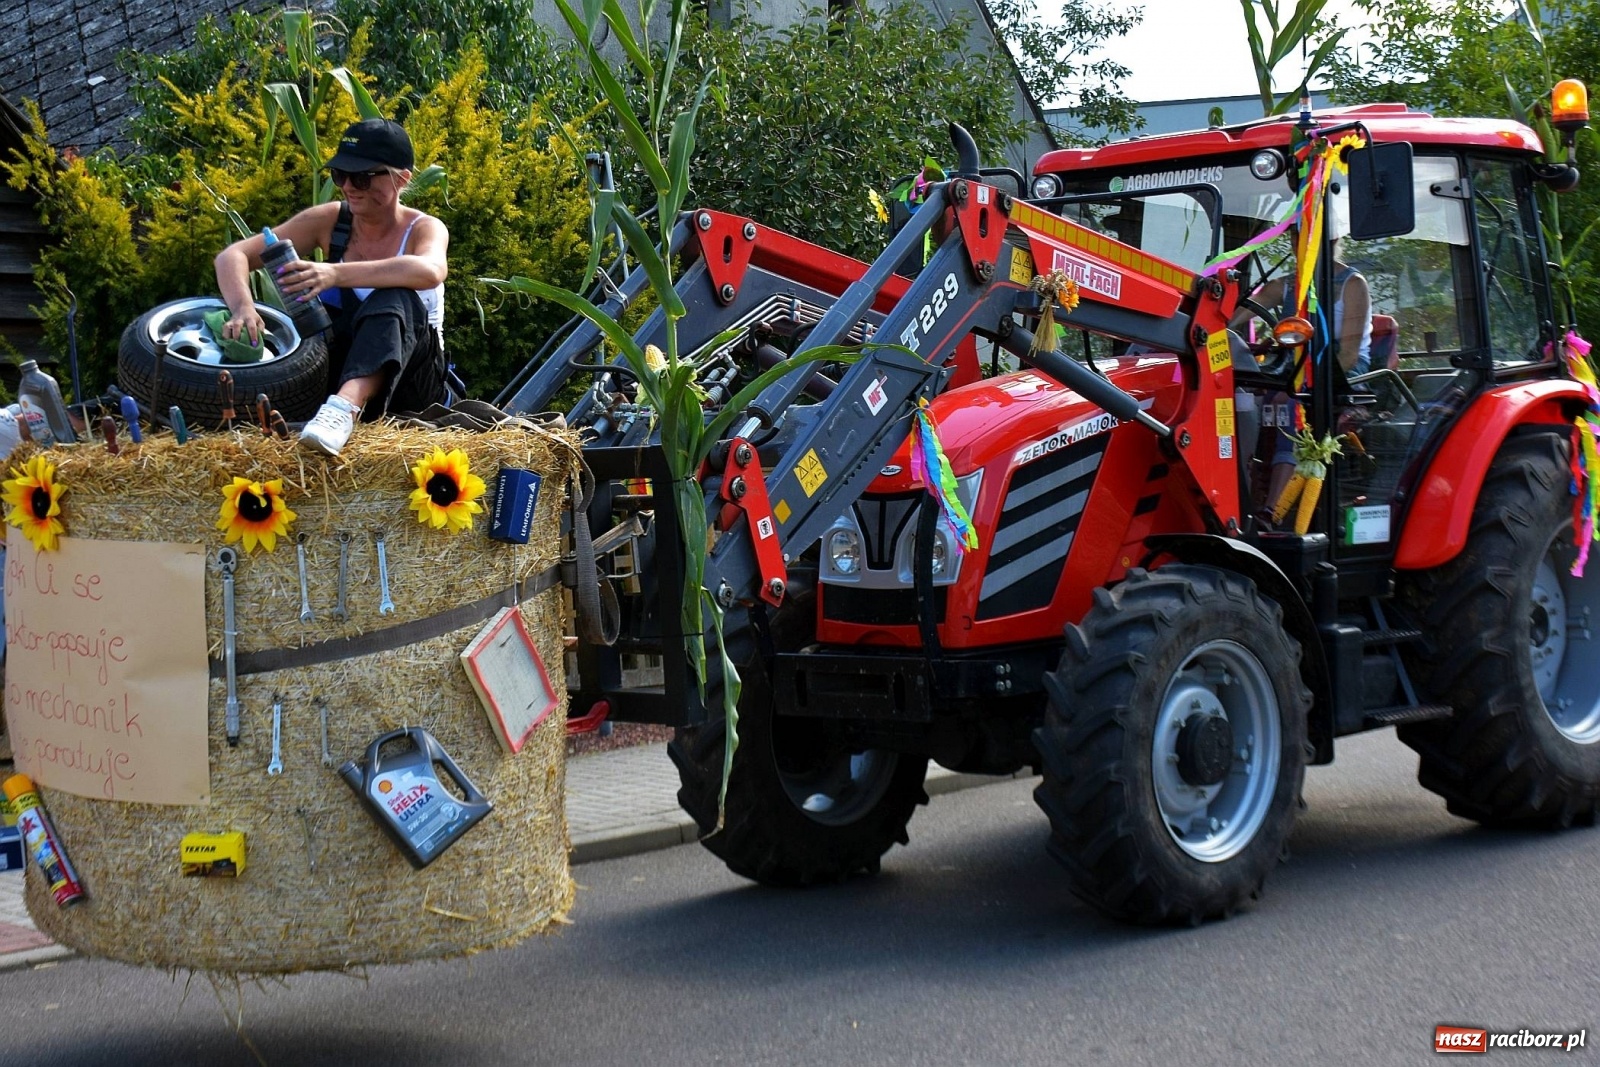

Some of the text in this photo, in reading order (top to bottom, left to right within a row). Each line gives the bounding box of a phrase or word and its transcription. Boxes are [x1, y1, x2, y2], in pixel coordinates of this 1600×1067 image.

[1127, 165, 1224, 192] AGROKOMPLEKS
[920, 273, 959, 334] 229
[1211, 349, 1230, 366] 1300
[1021, 414, 1119, 463] ZETOR MAJOR
[72, 573, 103, 601] se
[26, 683, 143, 738] mechanik
[392, 783, 430, 815] HELIX
[399, 793, 434, 822] ULTRA
[185, 845, 217, 853] TEXTAR
